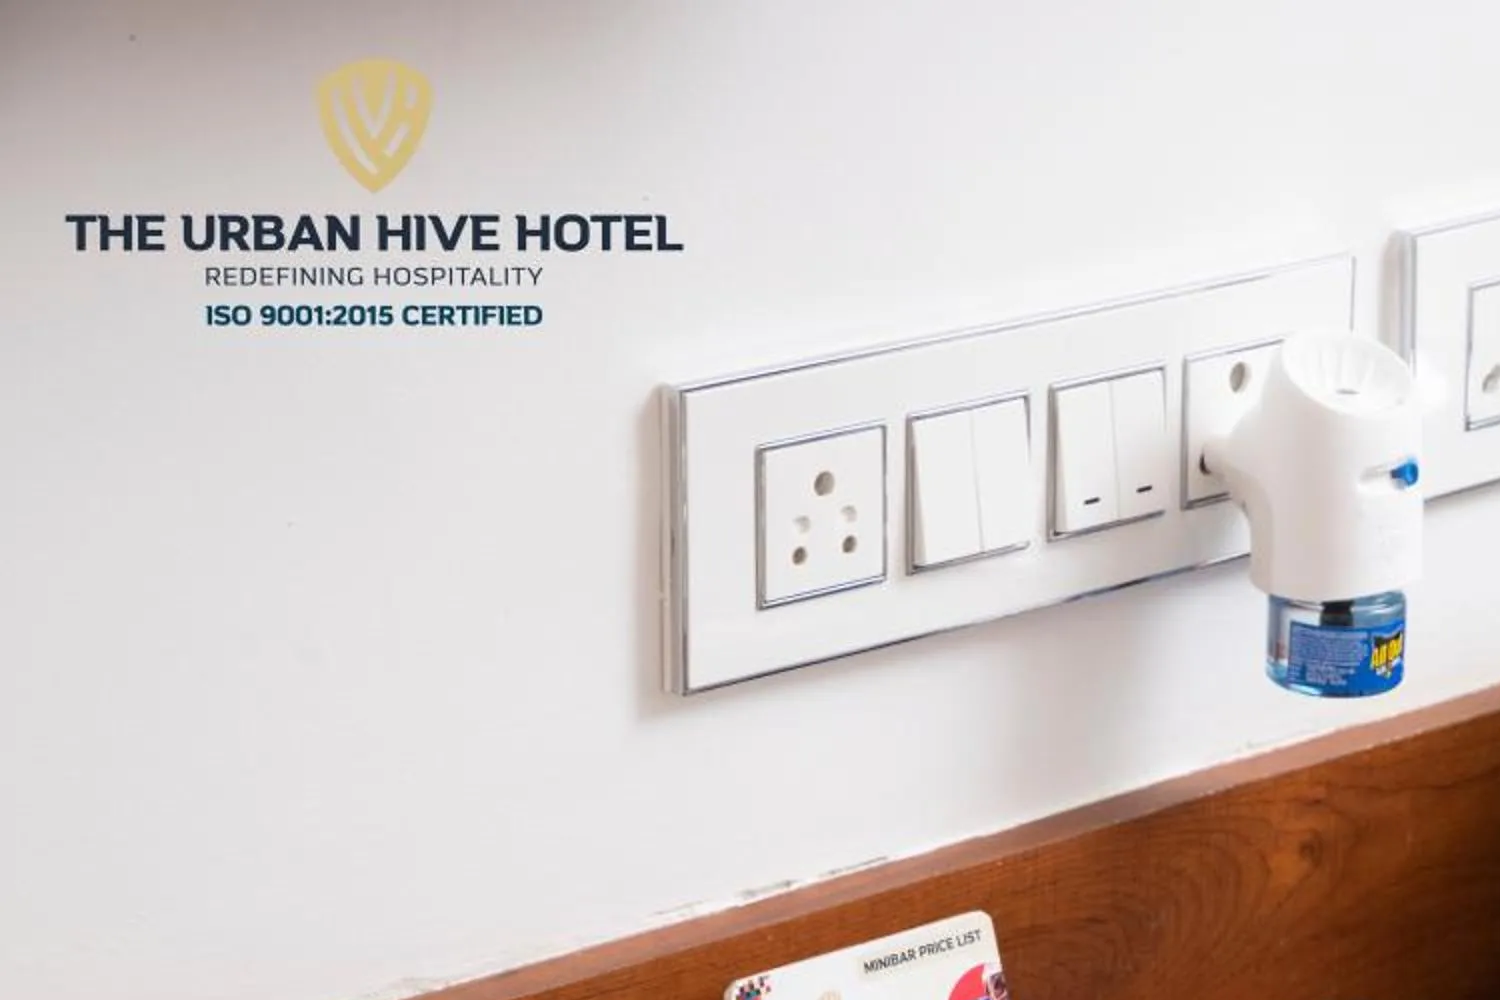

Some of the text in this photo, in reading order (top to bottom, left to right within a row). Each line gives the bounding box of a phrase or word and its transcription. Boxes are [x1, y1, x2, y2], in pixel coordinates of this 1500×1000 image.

[863, 929, 981, 973] MINIBAR PRICE LIST
